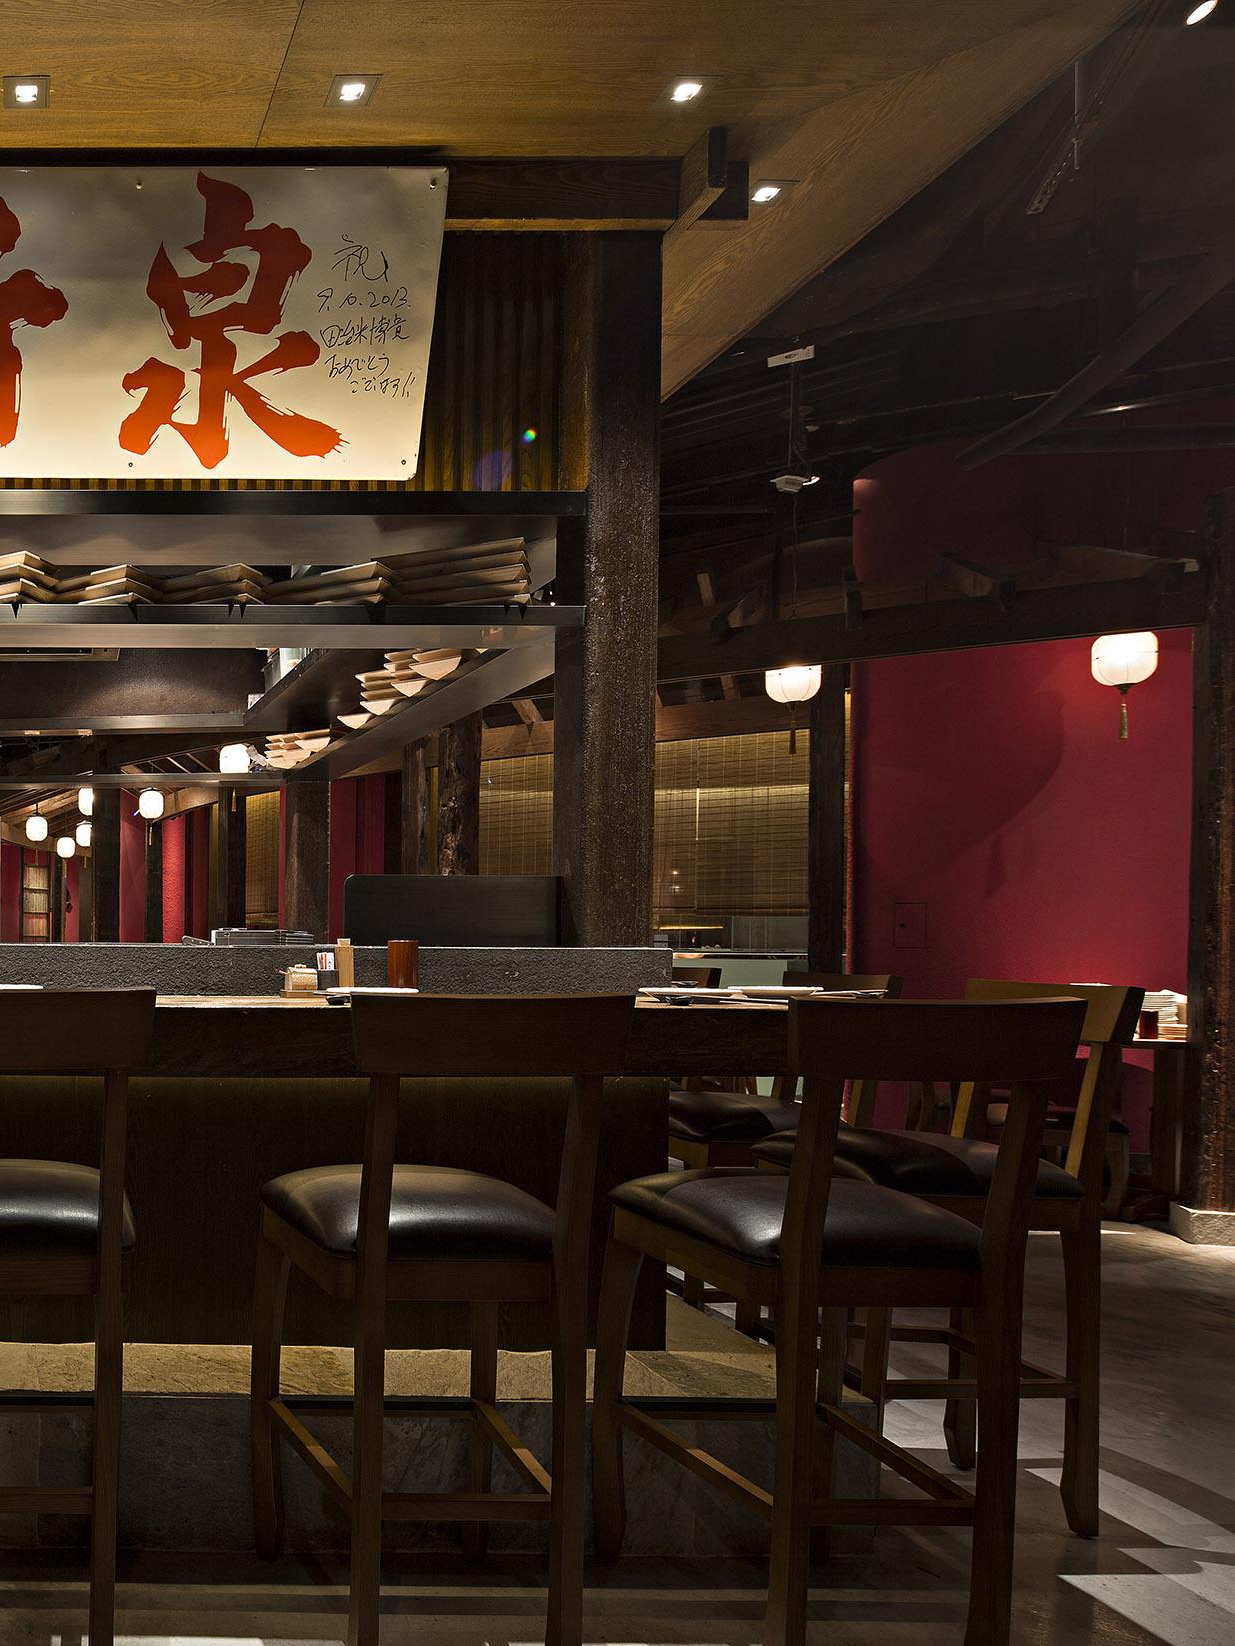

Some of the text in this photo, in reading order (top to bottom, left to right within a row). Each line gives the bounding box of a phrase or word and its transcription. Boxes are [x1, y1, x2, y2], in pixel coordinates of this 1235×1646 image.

[324, 353, 390, 380] おめでとう
